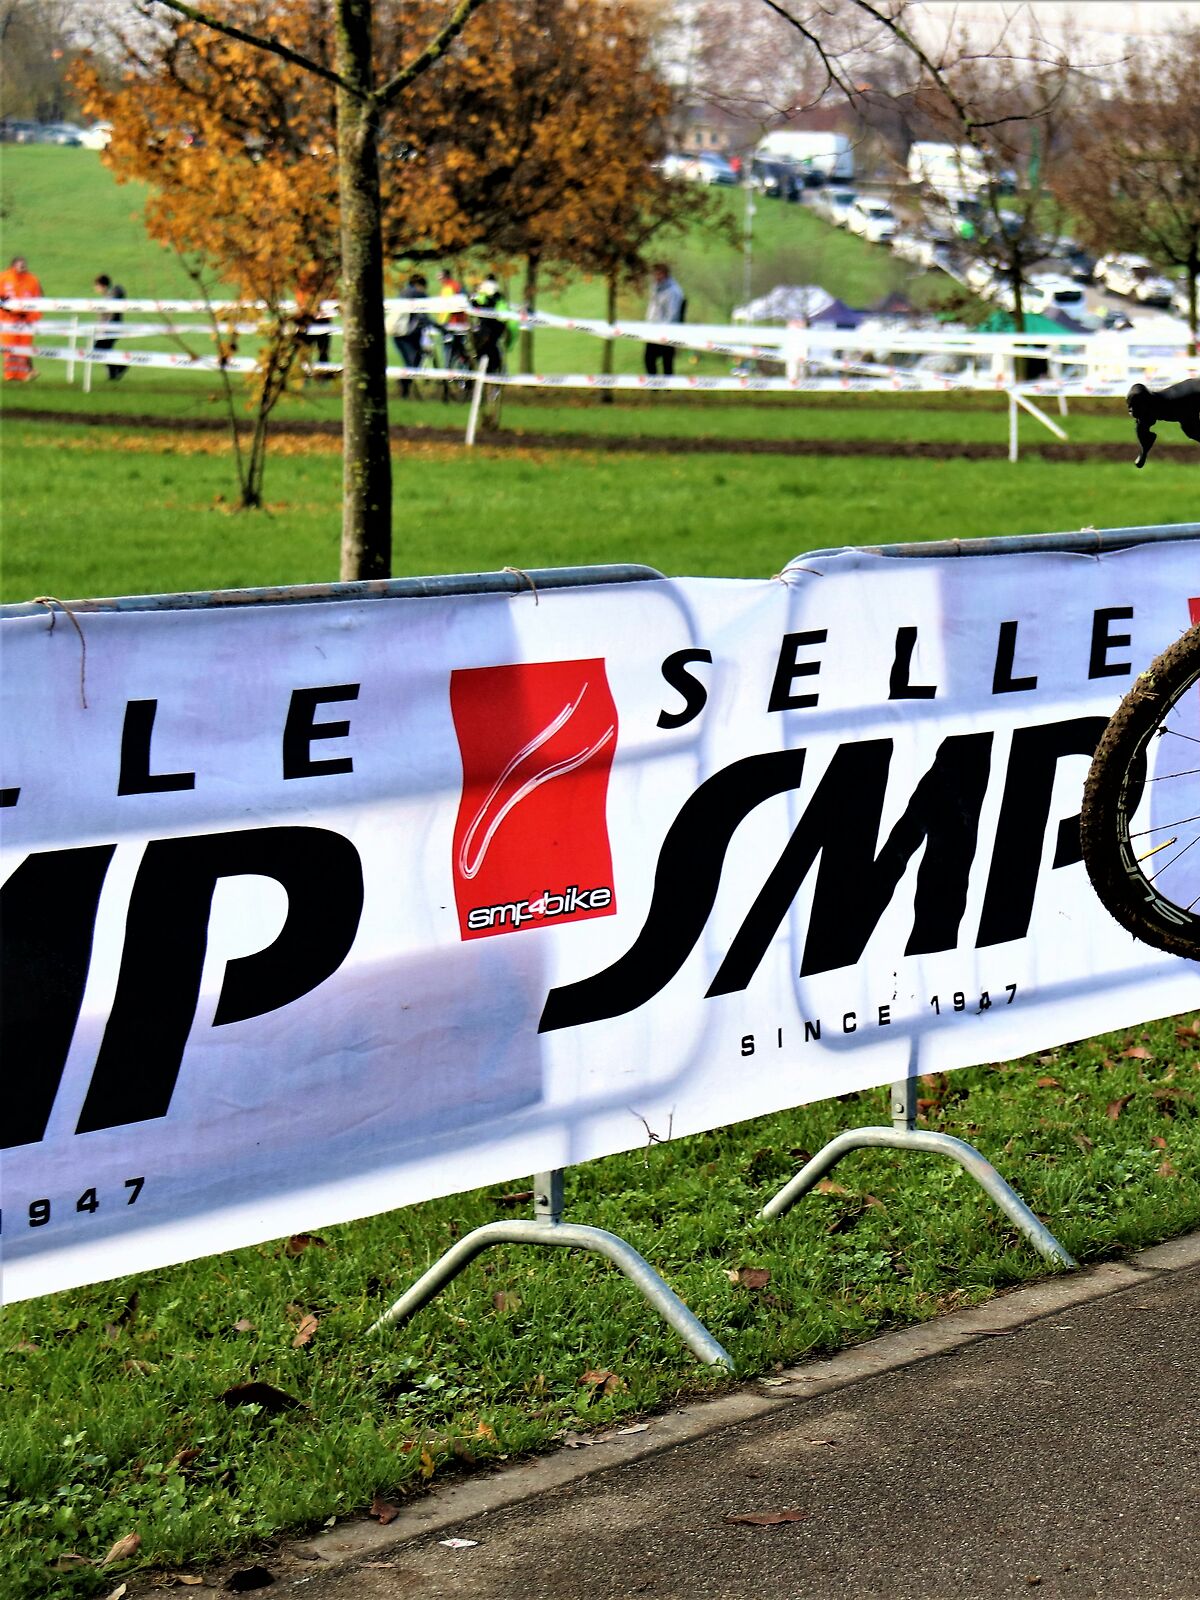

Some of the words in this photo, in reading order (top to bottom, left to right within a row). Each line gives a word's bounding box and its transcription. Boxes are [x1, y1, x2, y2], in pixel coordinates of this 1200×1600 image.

[656, 606, 1135, 730] SELLE
[0, 683, 360, 807] LE
[468, 886, 613, 930] smp4bike
[537, 715, 1148, 1035] SMP
[740, 1004, 893, 1058] SINCE
[930, 983, 1020, 1016] 1947
[0, 1177, 146, 1236] 947
